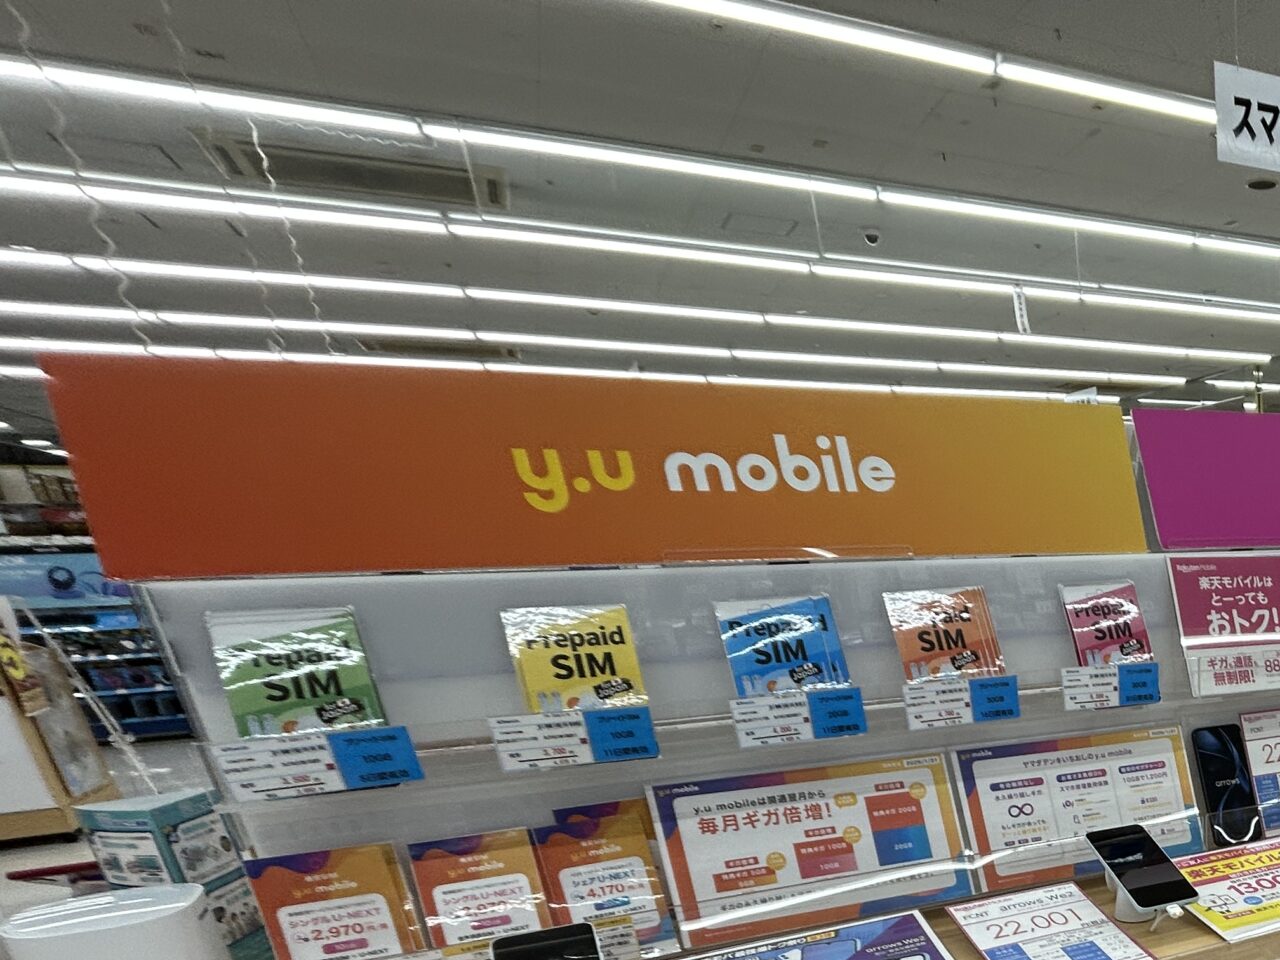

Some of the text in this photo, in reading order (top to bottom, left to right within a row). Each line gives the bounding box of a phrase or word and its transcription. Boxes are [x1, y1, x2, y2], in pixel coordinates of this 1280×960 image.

[513, 434, 896, 512] y.u mobile
[1198, 575, 1273, 590] 楽天モバイルは
[1073, 599, 1134, 619] Prepa
[1211, 592, 1268, 606] とーっても
[1092, 620, 1133, 641] SIM
[1206, 607, 1280, 636] おトク!
[751, 639, 808, 665] SIM
[917, 628, 967, 652] SIM
[551, 651, 617, 680] SIM
[262, 669, 344, 702] SIM
[698, 802, 833, 836] 毎月ギガ倍増!
[1000, 891, 1075, 912] arrows We2
[985, 908, 1083, 940] 22,001
[865, 940, 903, 953] arrows
